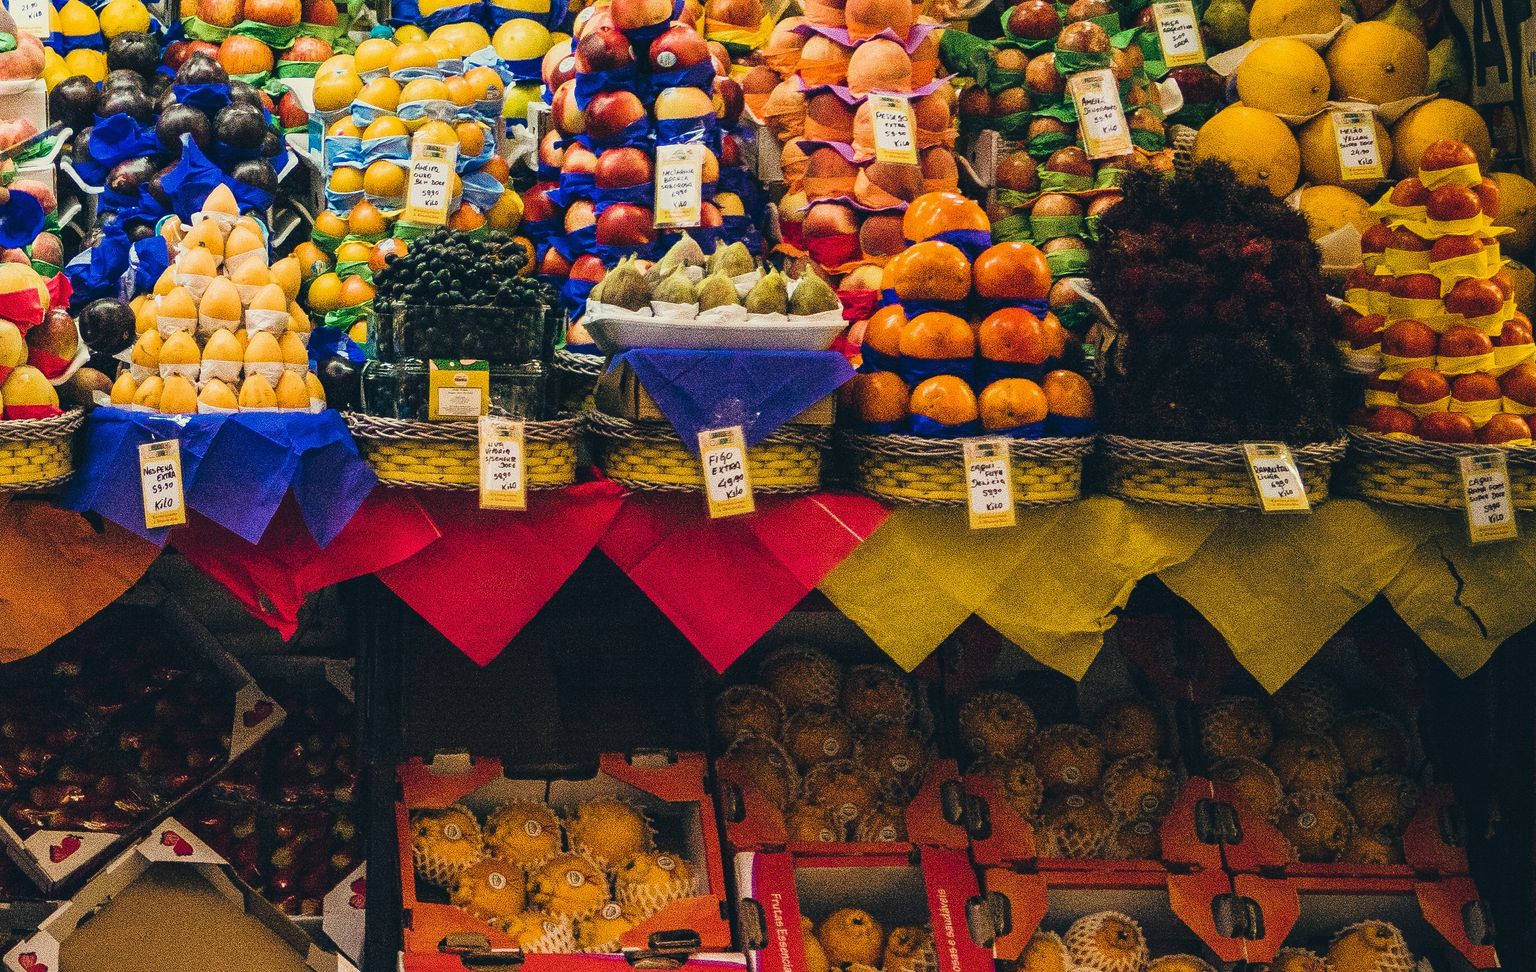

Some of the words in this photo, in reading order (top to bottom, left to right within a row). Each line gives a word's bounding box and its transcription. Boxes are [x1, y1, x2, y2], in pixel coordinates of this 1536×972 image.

[709, 452, 734, 466] FIGO
[712, 461, 741, 475] EXTRA
[156, 471, 177, 481] EXTRA
[771, 893, 784, 927] Frutas
